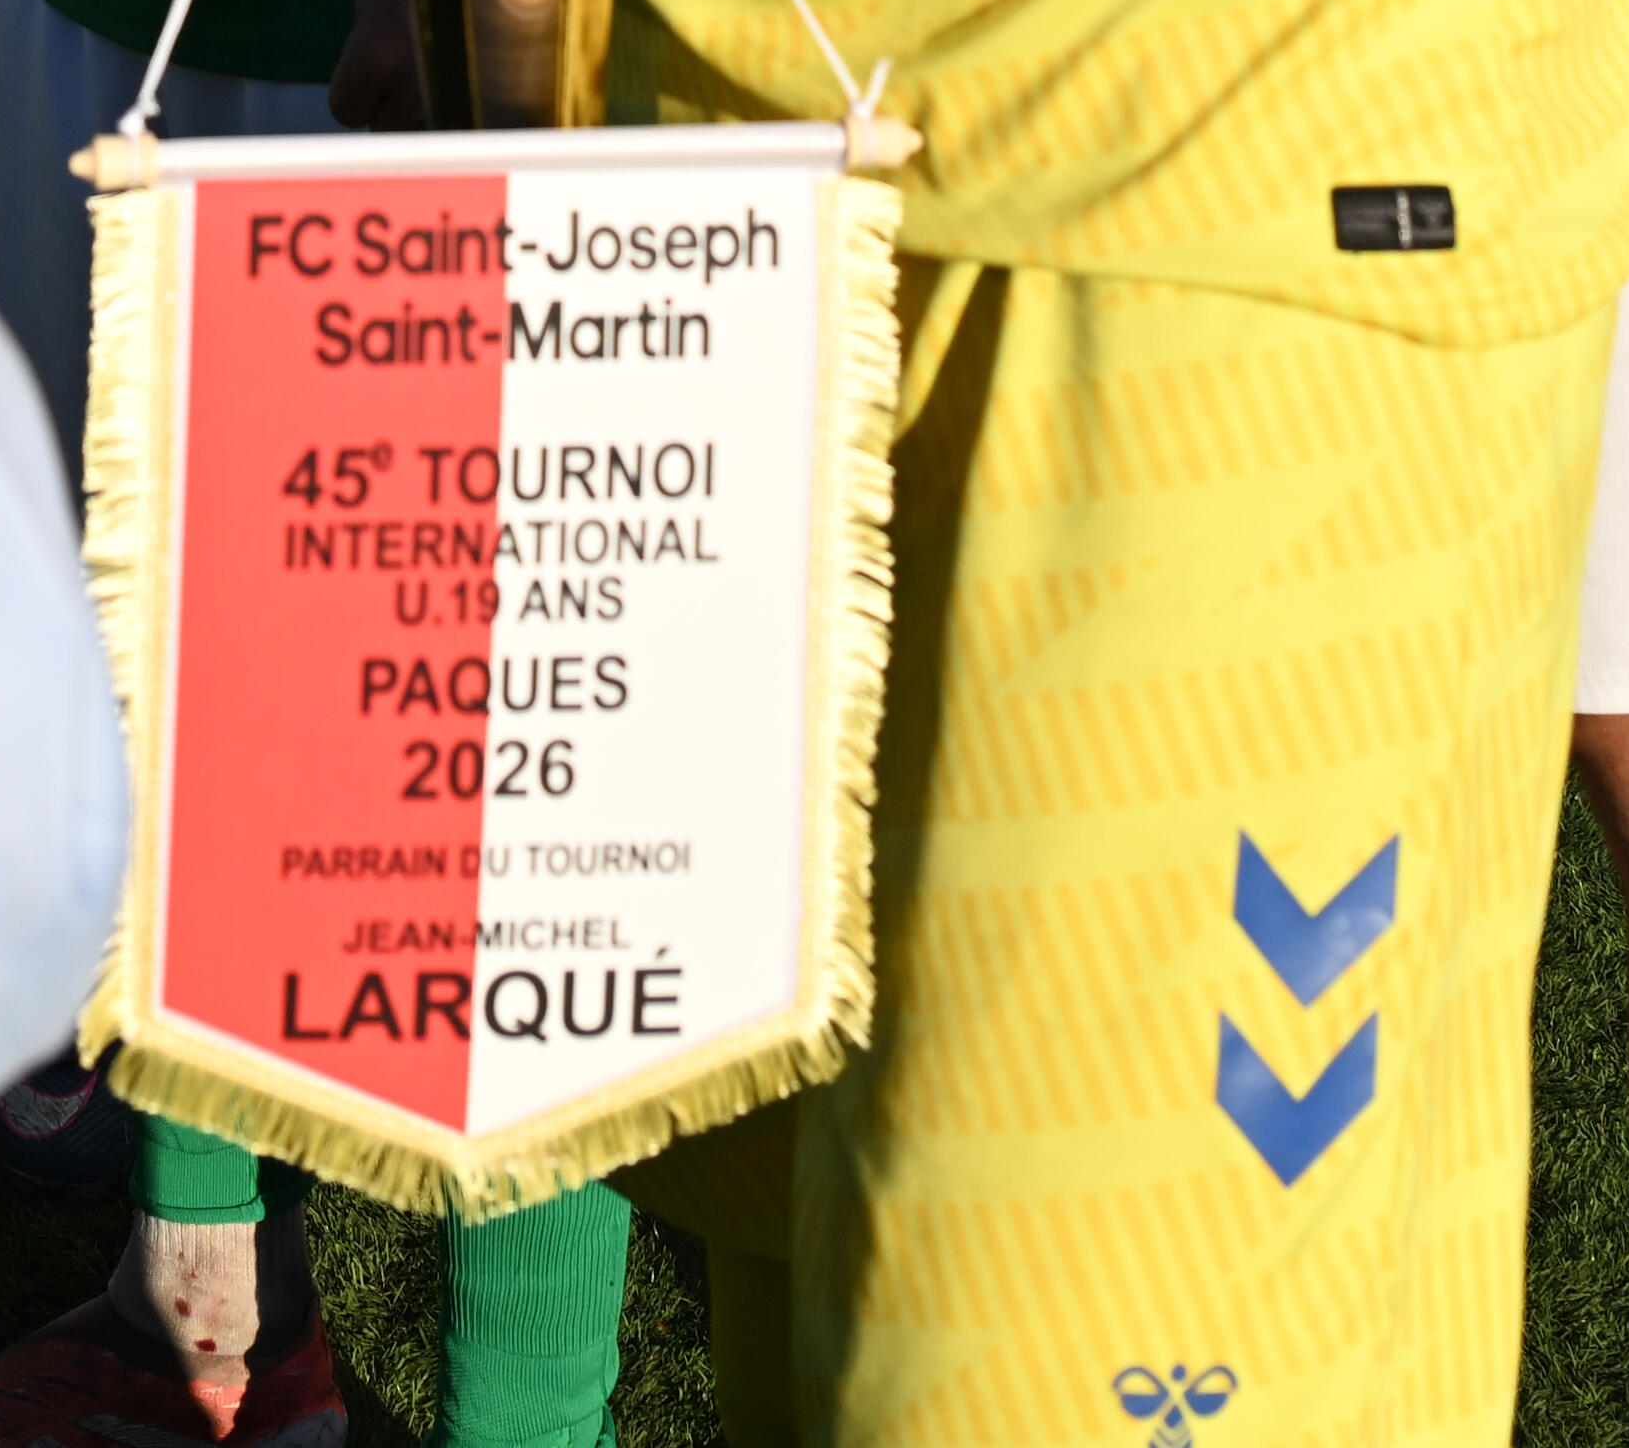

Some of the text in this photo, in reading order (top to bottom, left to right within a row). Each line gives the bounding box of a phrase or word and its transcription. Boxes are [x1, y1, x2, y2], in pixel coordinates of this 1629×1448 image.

[247, 207, 780, 286] FC Saint-Joseph
[315, 299, 711, 367] Saint-Martin
[419, 441, 713, 505] TOURNOI
[284, 517, 721, 569] INTERNATIONAL
[395, 575, 626, 627] U.19 ANS
[358, 655, 631, 717] PAQUES
[401, 738, 576, 801] 2026
[280, 840, 693, 881] PARRAIN DU TOURNOI
[342, 917, 631, 954] JEAN-MICHEL
[282, 945, 684, 1041] LARQUÉ
